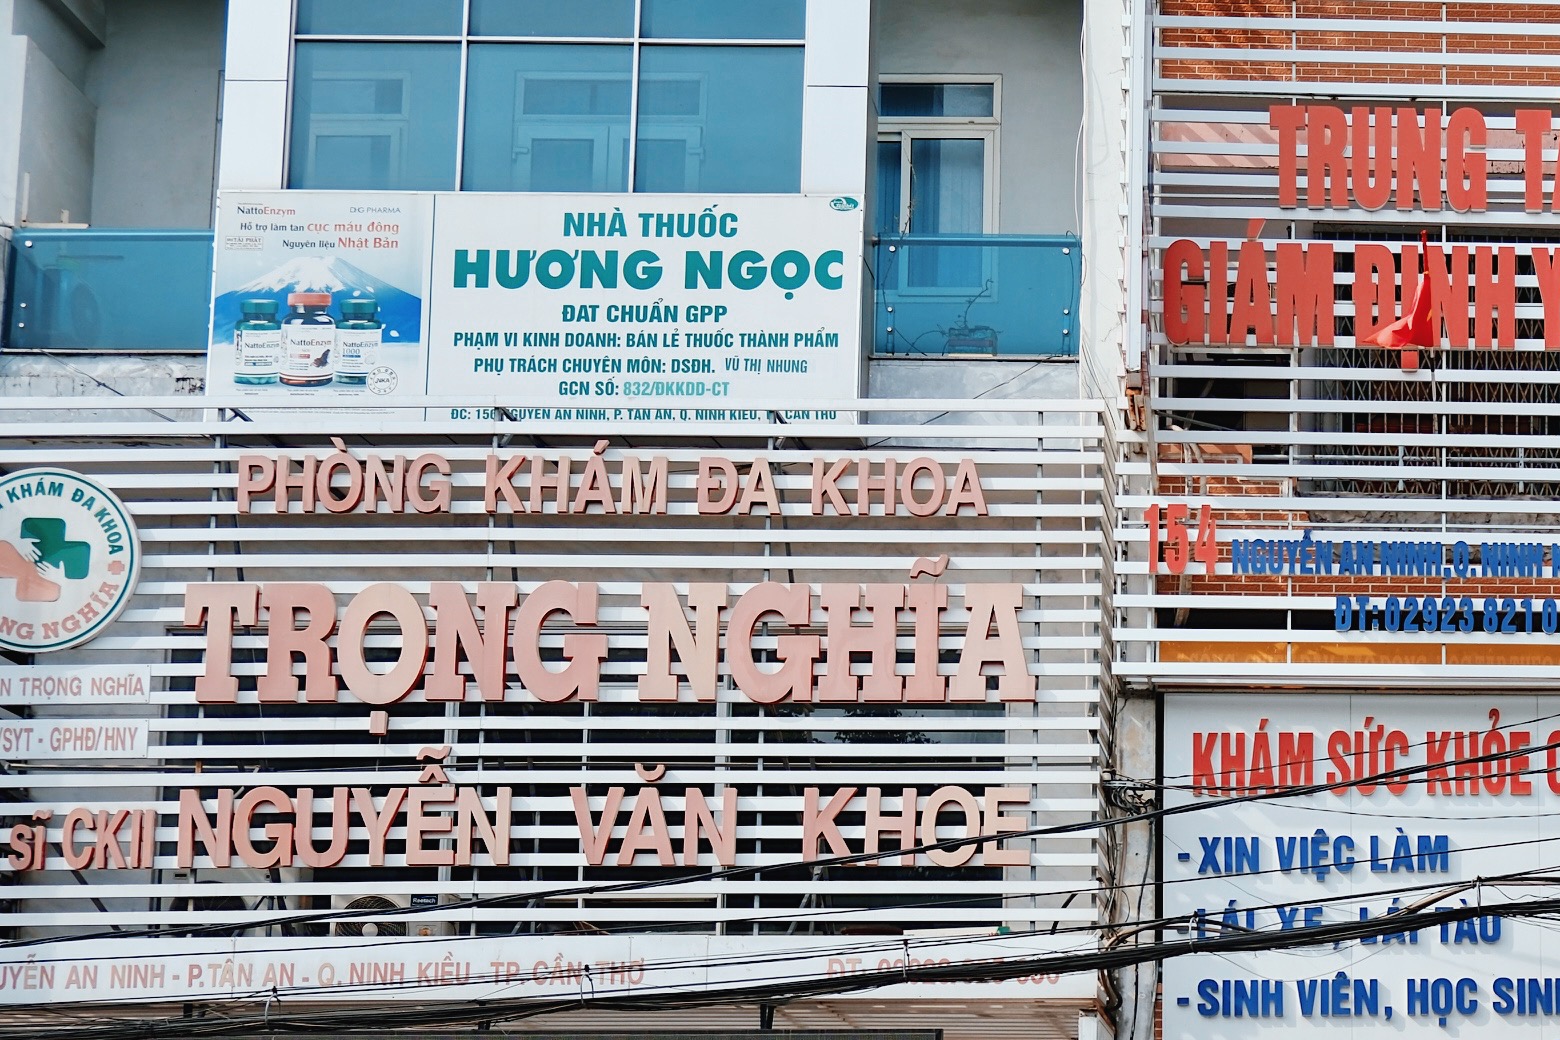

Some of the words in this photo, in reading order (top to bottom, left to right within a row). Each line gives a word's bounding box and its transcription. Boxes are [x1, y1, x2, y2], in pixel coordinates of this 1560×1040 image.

[1269, 104, 1487, 213] TRUNG
[237, 206, 296, 217] NattoEnzym
[366, 206, 402, 214] PHARMA
[290, 224, 305, 232] tan
[563, 207, 627, 238] NHÀ
[639, 204, 738, 238] THUỐC
[338, 236, 369, 251] Nhật
[372, 236, 399, 249] Bản
[453, 248, 663, 290] HƯƠNG
[685, 249, 844, 300] NGỌC
[1163, 219, 1334, 347] GIÁM
[606, 298, 679, 323] CHUẨN
[686, 306, 728, 323] GPP
[453, 332, 499, 350] PHẠM
[504, 332, 518, 347] VI
[523, 333, 560, 347] KINH
[565, 333, 621, 347] DOANH:
[626, 330, 658, 347] BÁN
[663, 328, 679, 347] LẺ
[685, 328, 734, 347] THUỐC
[739, 328, 789, 347] THÀNH
[794, 327, 839, 347] PHẨM
[474, 358, 504, 376] PHỤ
[509, 355, 557, 373] TRÁCH
[562, 356, 621, 373] CHUYÊN
[627, 356, 666, 373] MÔN:
[671, 358, 715, 373] DSĐH.
[725, 355, 740, 371] VŨ
[744, 358, 761, 374] THỊ
[767, 359, 808, 373] NHUNG
[559, 381, 590, 396] GCN
[595, 376, 620, 396] SỐ:
[237, 437, 451, 515] PHÒNG
[485, 440, 668, 516] KHÁM
[696, 457, 781, 516] ĐA
[811, 457, 989, 517] KHOA
[6, 478, 65, 502] KHÁM
[71, 487, 96, 512] ĐA
[93, 508, 125, 556] KHOA
[1144, 503, 1219, 575] 154
[184, 580, 608, 736] TRỌNG
[636, 554, 1037, 703] NGHĨA
[91, 673, 145, 697] NGHĨA
[1192, 717, 1313, 797] KHÁM
[1326, 716, 1410, 797] SỨC
[1426, 708, 1532, 797] KHỎE
[177, 745, 512, 869] NGUYỄN
[569, 763, 738, 867] VĂN
[1197, 836, 1260, 875] XIN
[1276, 828, 1355, 883] VIỆC
[1369, 827, 1450, 874] LÀM
[65, 965, 98, 989] AN
[110, 965, 165, 989] NINH
[262, 962, 296, 988] AN
[350, 962, 405, 987] NINH
[1197, 978, 1284, 1018] SINH
[1297, 972, 1393, 1020] VIÊN,
[1407, 978, 1479, 1026] HỌC
